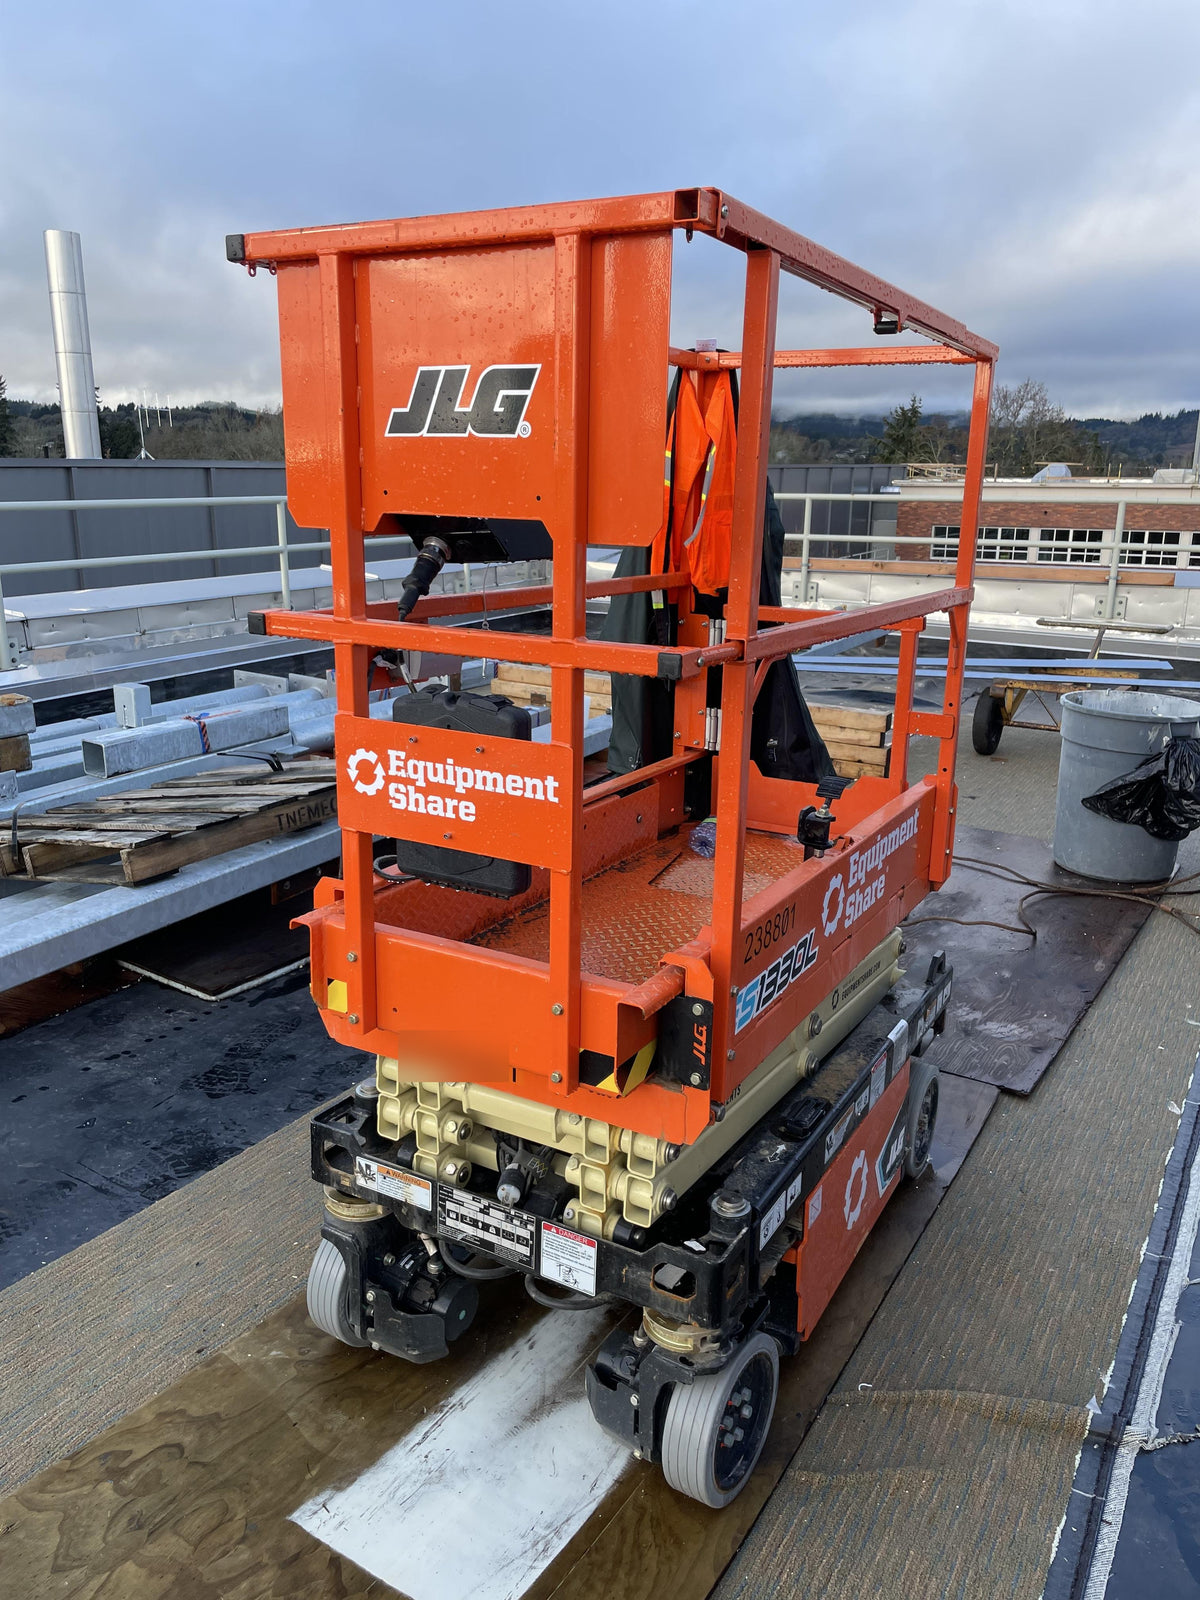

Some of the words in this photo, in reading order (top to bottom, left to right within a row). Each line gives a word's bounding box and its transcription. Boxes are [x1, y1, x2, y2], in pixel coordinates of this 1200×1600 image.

[384, 364, 542, 438] JLG
[388, 749, 559, 803] Equipment
[388, 783, 476, 822] Share
[848, 807, 920, 888] Equipment
[844, 872, 886, 928] Share
[744, 903, 796, 964] 238801
[692, 1022, 707, 1066] JLG
[391, 1170, 421, 1186] WARNING
[558, 1229, 588, 1245] DANGER
